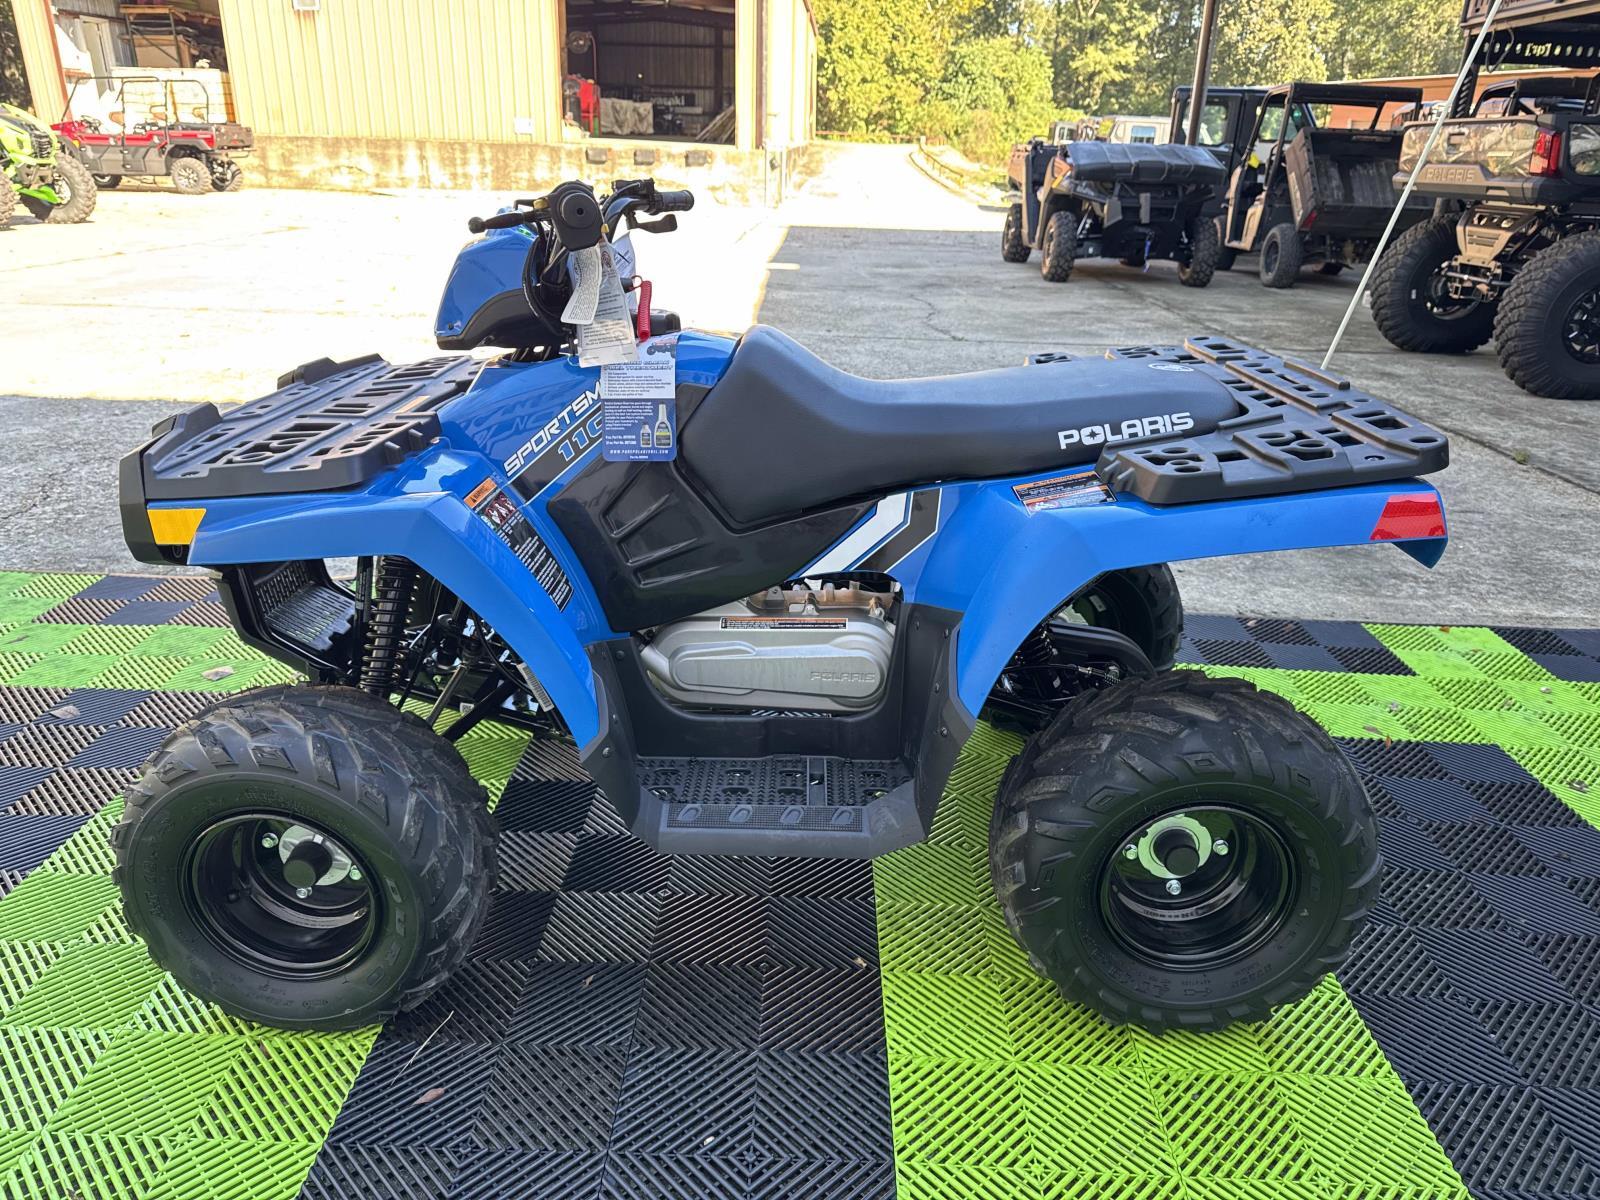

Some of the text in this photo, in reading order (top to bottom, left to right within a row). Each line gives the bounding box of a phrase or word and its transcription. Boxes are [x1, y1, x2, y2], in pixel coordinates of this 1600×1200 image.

[1426, 168, 1475, 182] POLARIS
[503, 381, 602, 477] SPORTSM
[1058, 412, 1195, 449] POLARIS
[810, 671, 876, 683] POLARIS
